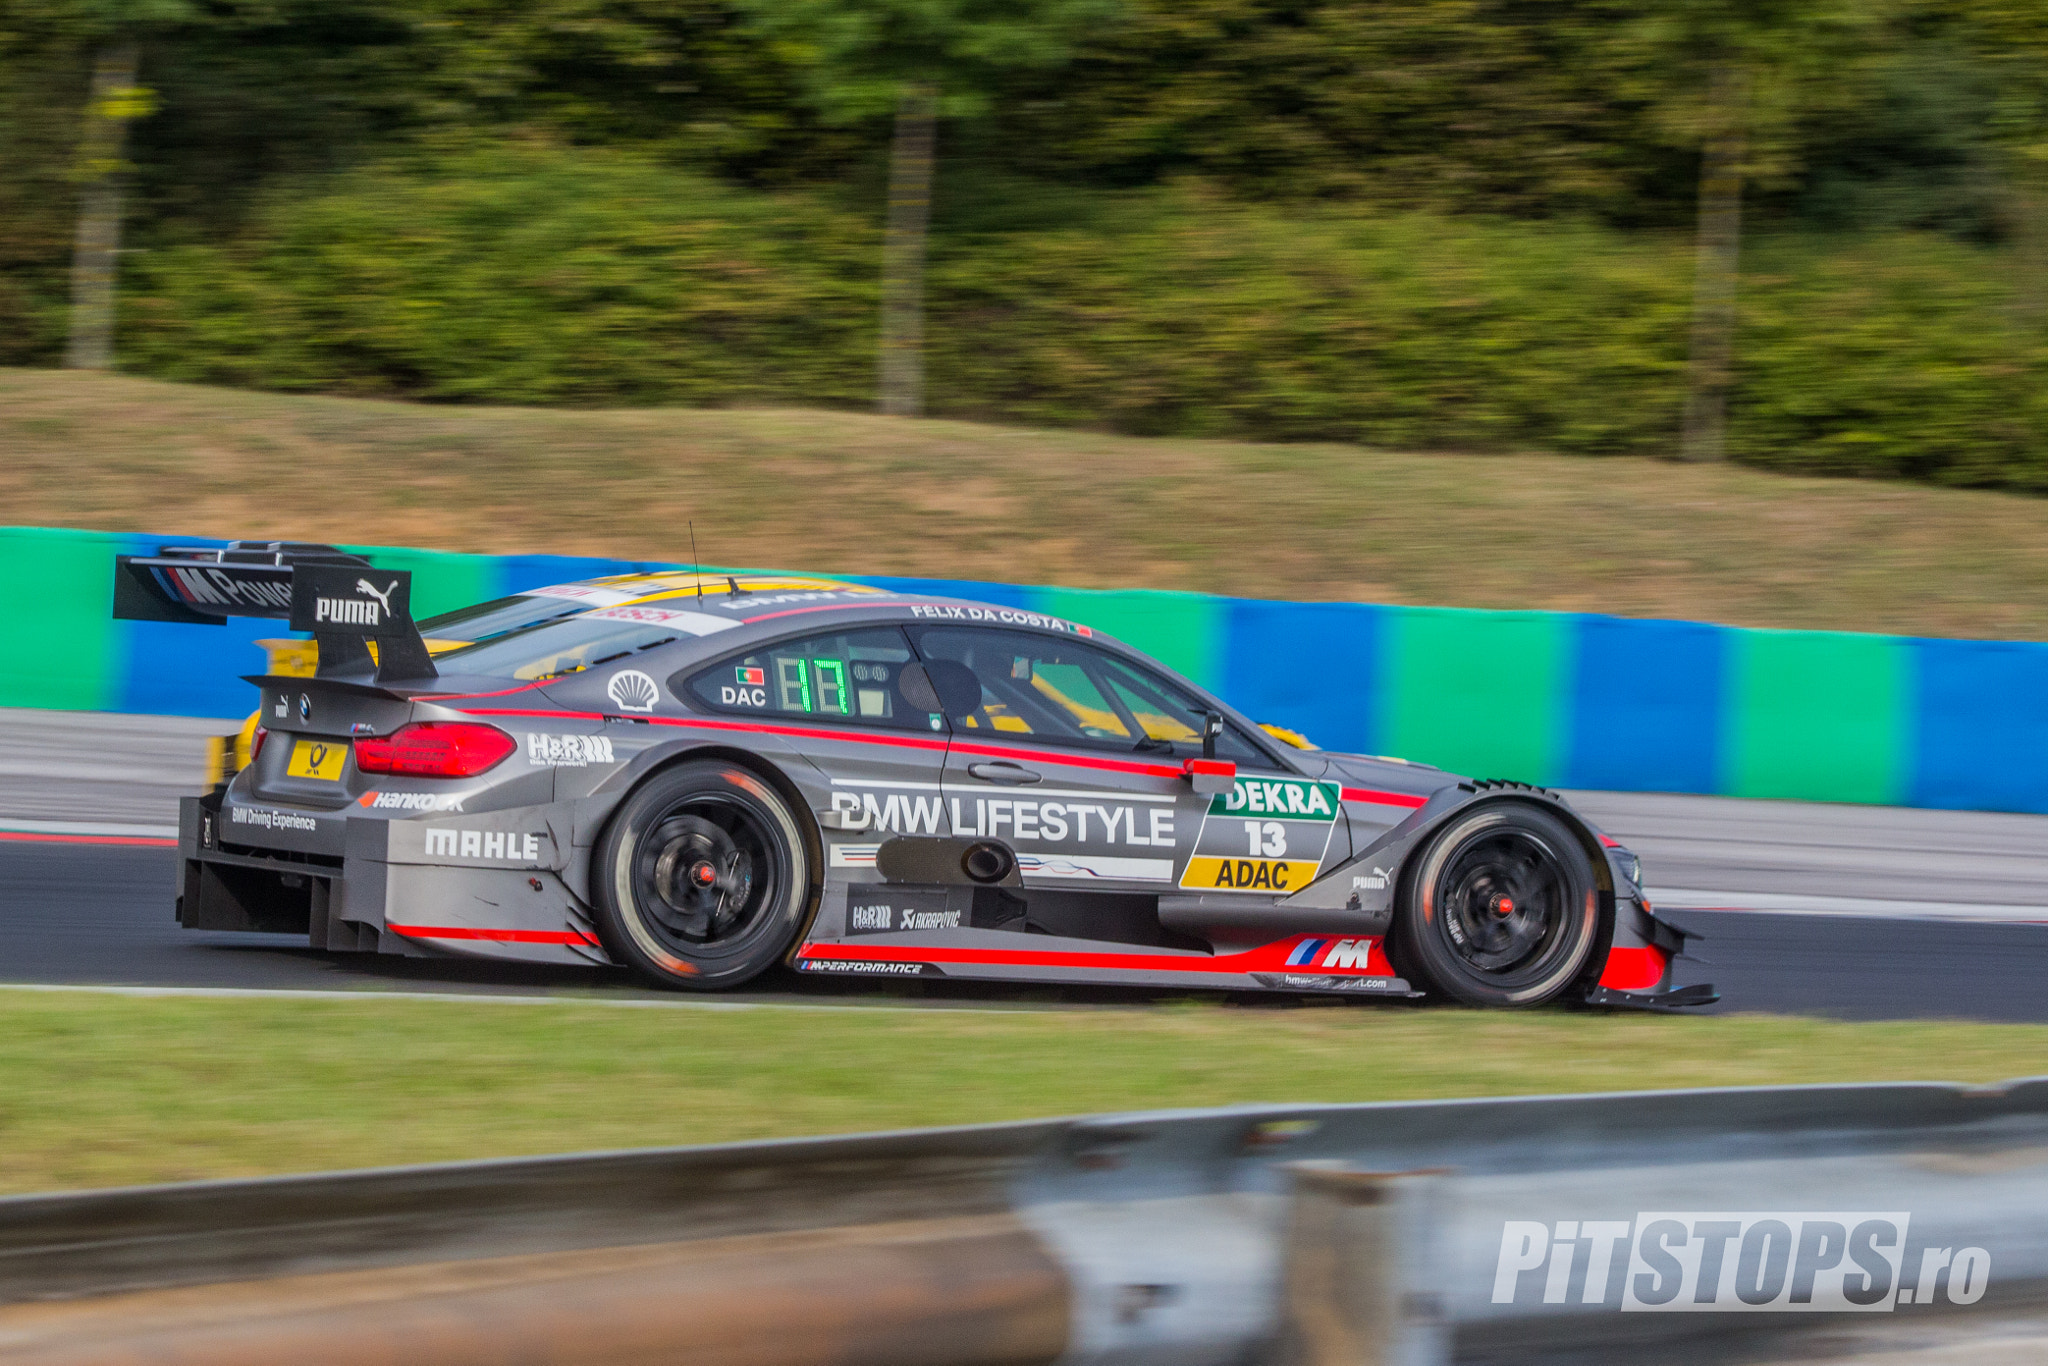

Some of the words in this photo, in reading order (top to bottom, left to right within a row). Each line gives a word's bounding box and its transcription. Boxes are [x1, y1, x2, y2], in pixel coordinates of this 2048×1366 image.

[205, 568, 292, 607] Powe
[316, 597, 379, 626] PUMA
[968, 608, 998, 622] DA
[1000, 611, 1065, 631] COSTA
[721, 686, 767, 707] DAC
[798, 658, 849, 715] 17
[1225, 782, 1332, 815] DEKRA
[248, 808, 272, 829] Driving
[272, 810, 316, 831] Experience
[832, 791, 943, 834] BMW
[951, 798, 1176, 847] LIFESTYLE
[425, 828, 539, 860] MAHLE
[1244, 821, 1288, 858] 13
[1215, 860, 1289, 890] ADAC
[1353, 876, 1386, 890] PUMA
[1321, 939, 1373, 969] M
